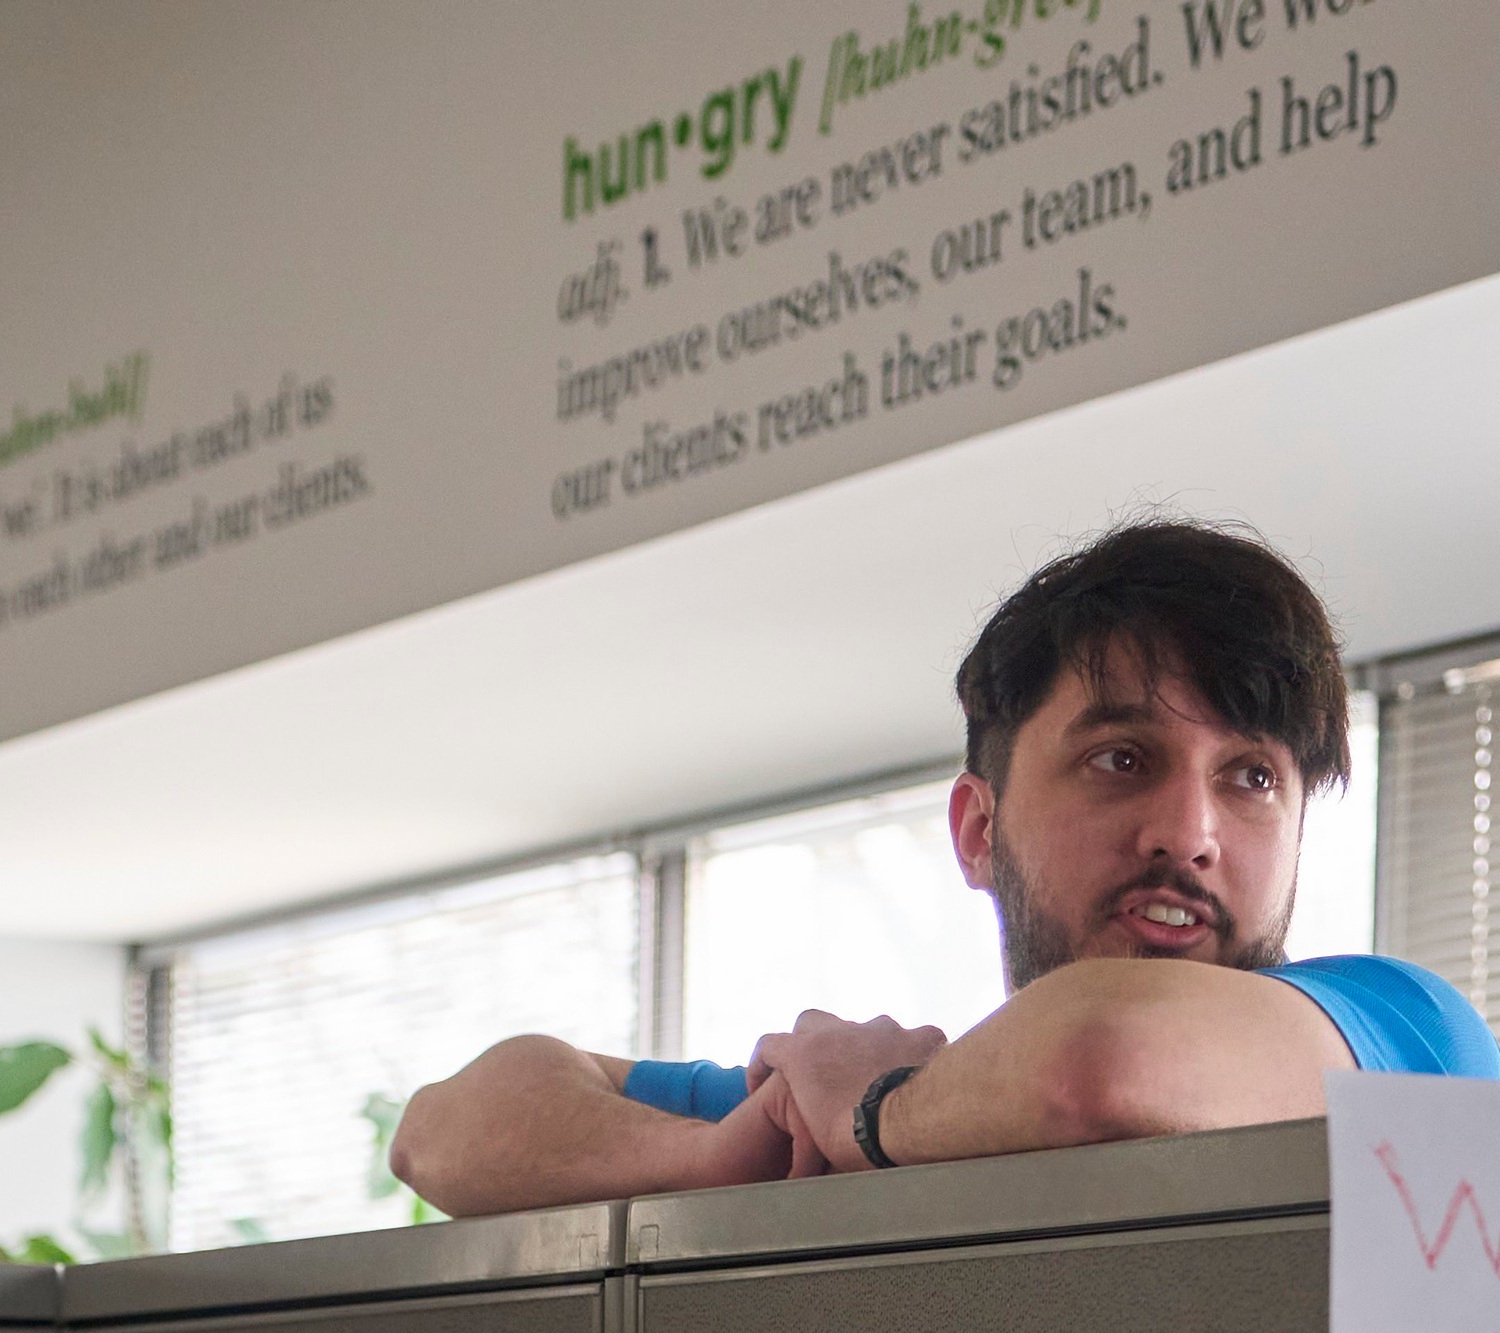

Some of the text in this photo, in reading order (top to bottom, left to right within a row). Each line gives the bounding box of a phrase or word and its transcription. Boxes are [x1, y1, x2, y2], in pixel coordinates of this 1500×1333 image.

[556, 238, 628, 328] adj.
[680, 198, 748, 268] We
[756, 177, 822, 246] are
[832, 122, 950, 216] never
[958, 15, 1166, 165] satisfied.
[1182, 0, 1267, 68] We
[558, 48, 1399, 422] improve ourselves, our team, and help
[552, 264, 1128, 522] our clients reach their goals.
